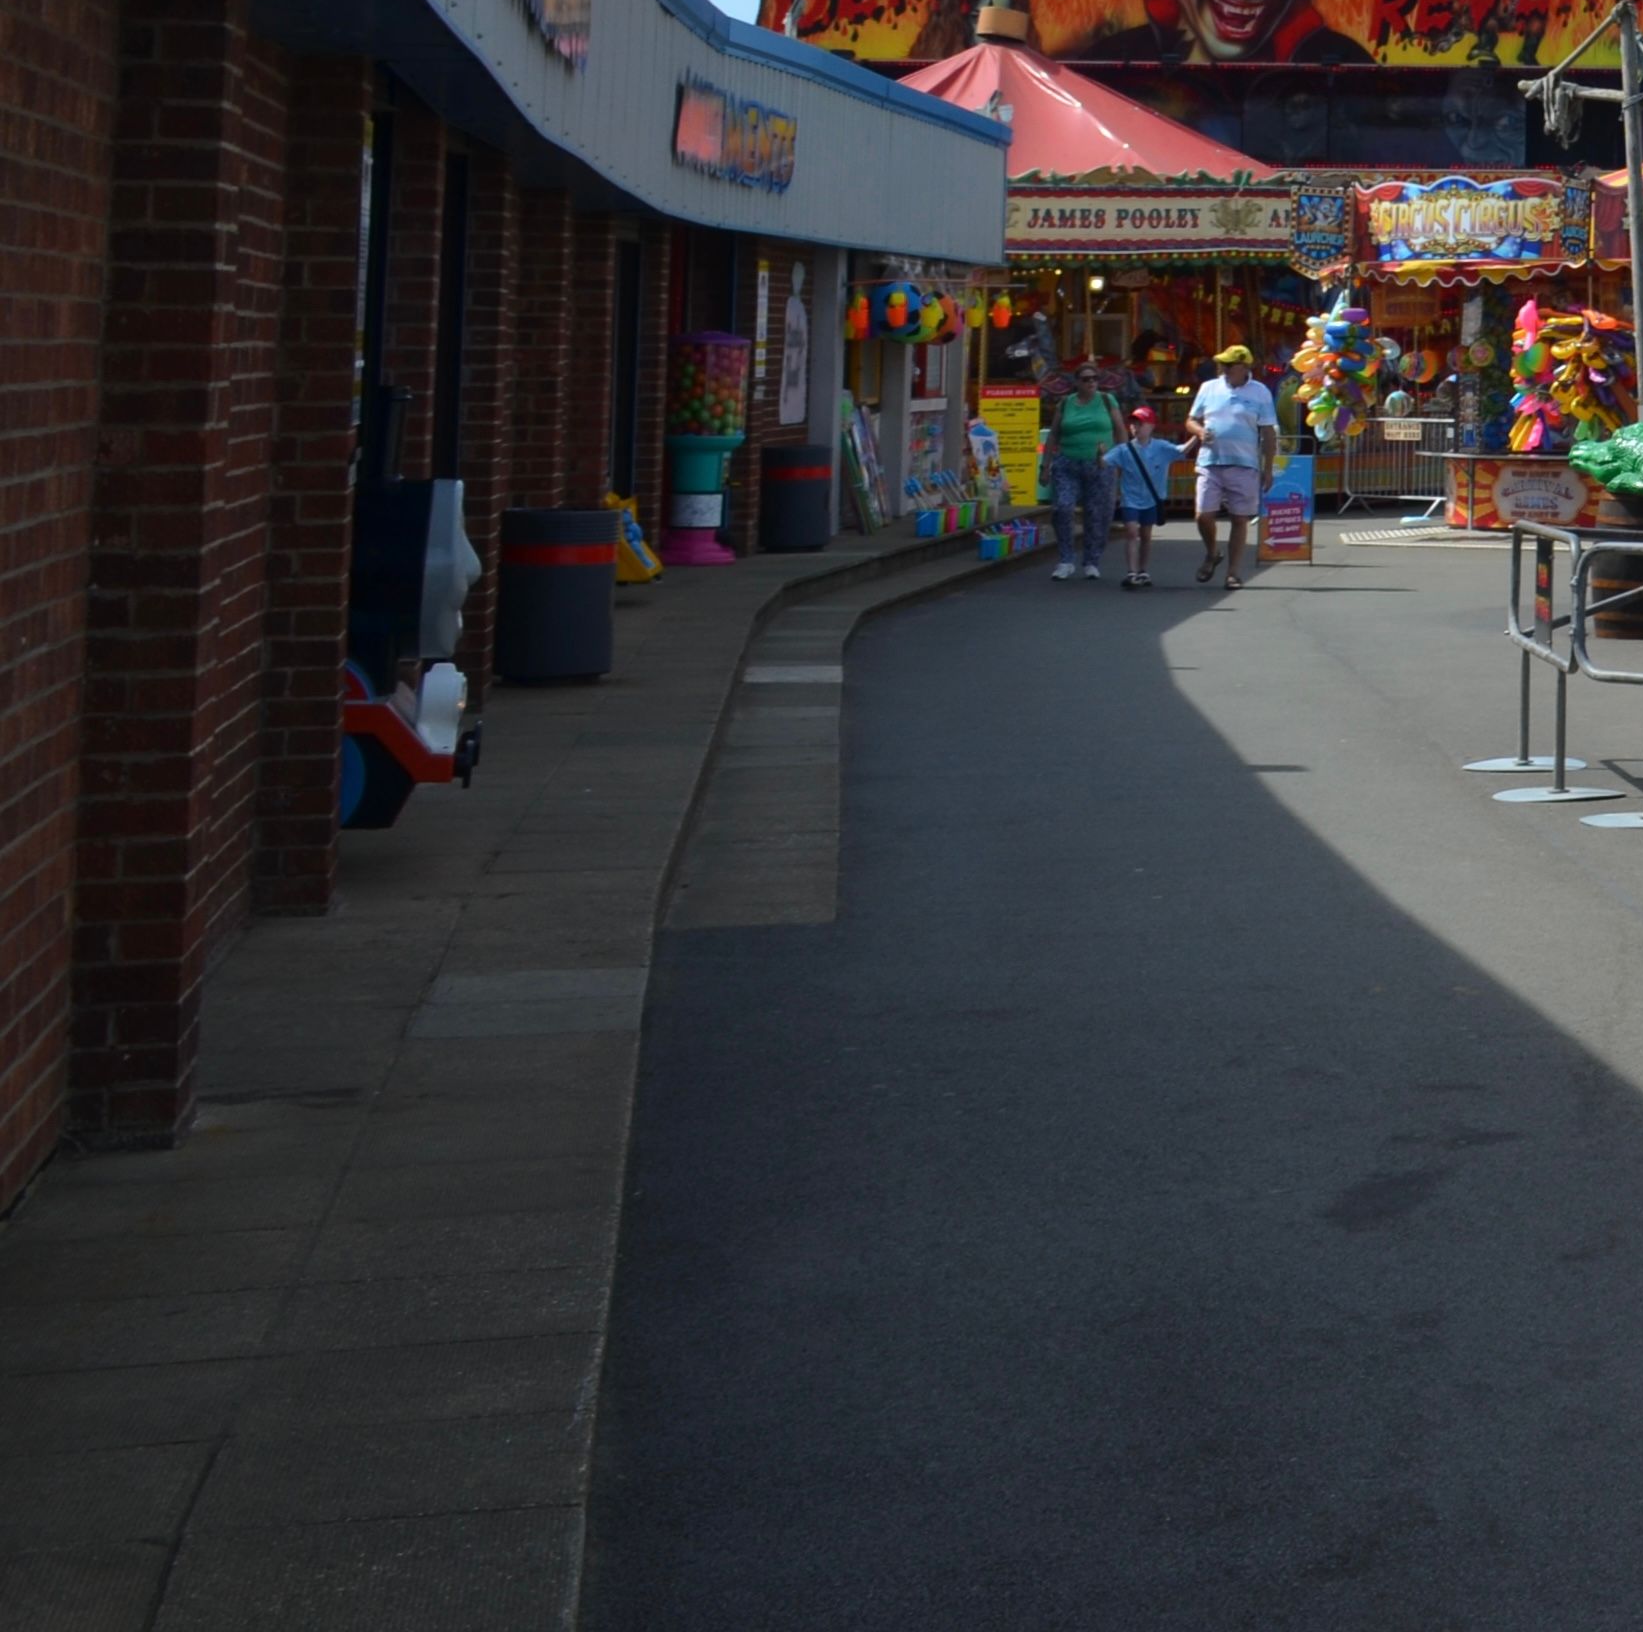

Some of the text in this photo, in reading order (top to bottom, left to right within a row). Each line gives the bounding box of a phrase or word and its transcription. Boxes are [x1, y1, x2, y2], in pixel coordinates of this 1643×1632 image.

[1027, 208, 1106, 229] JAMES
[1115, 207, 1202, 229] POOLEY
[1374, 194, 1544, 243] CIRCUS CIRCUS
